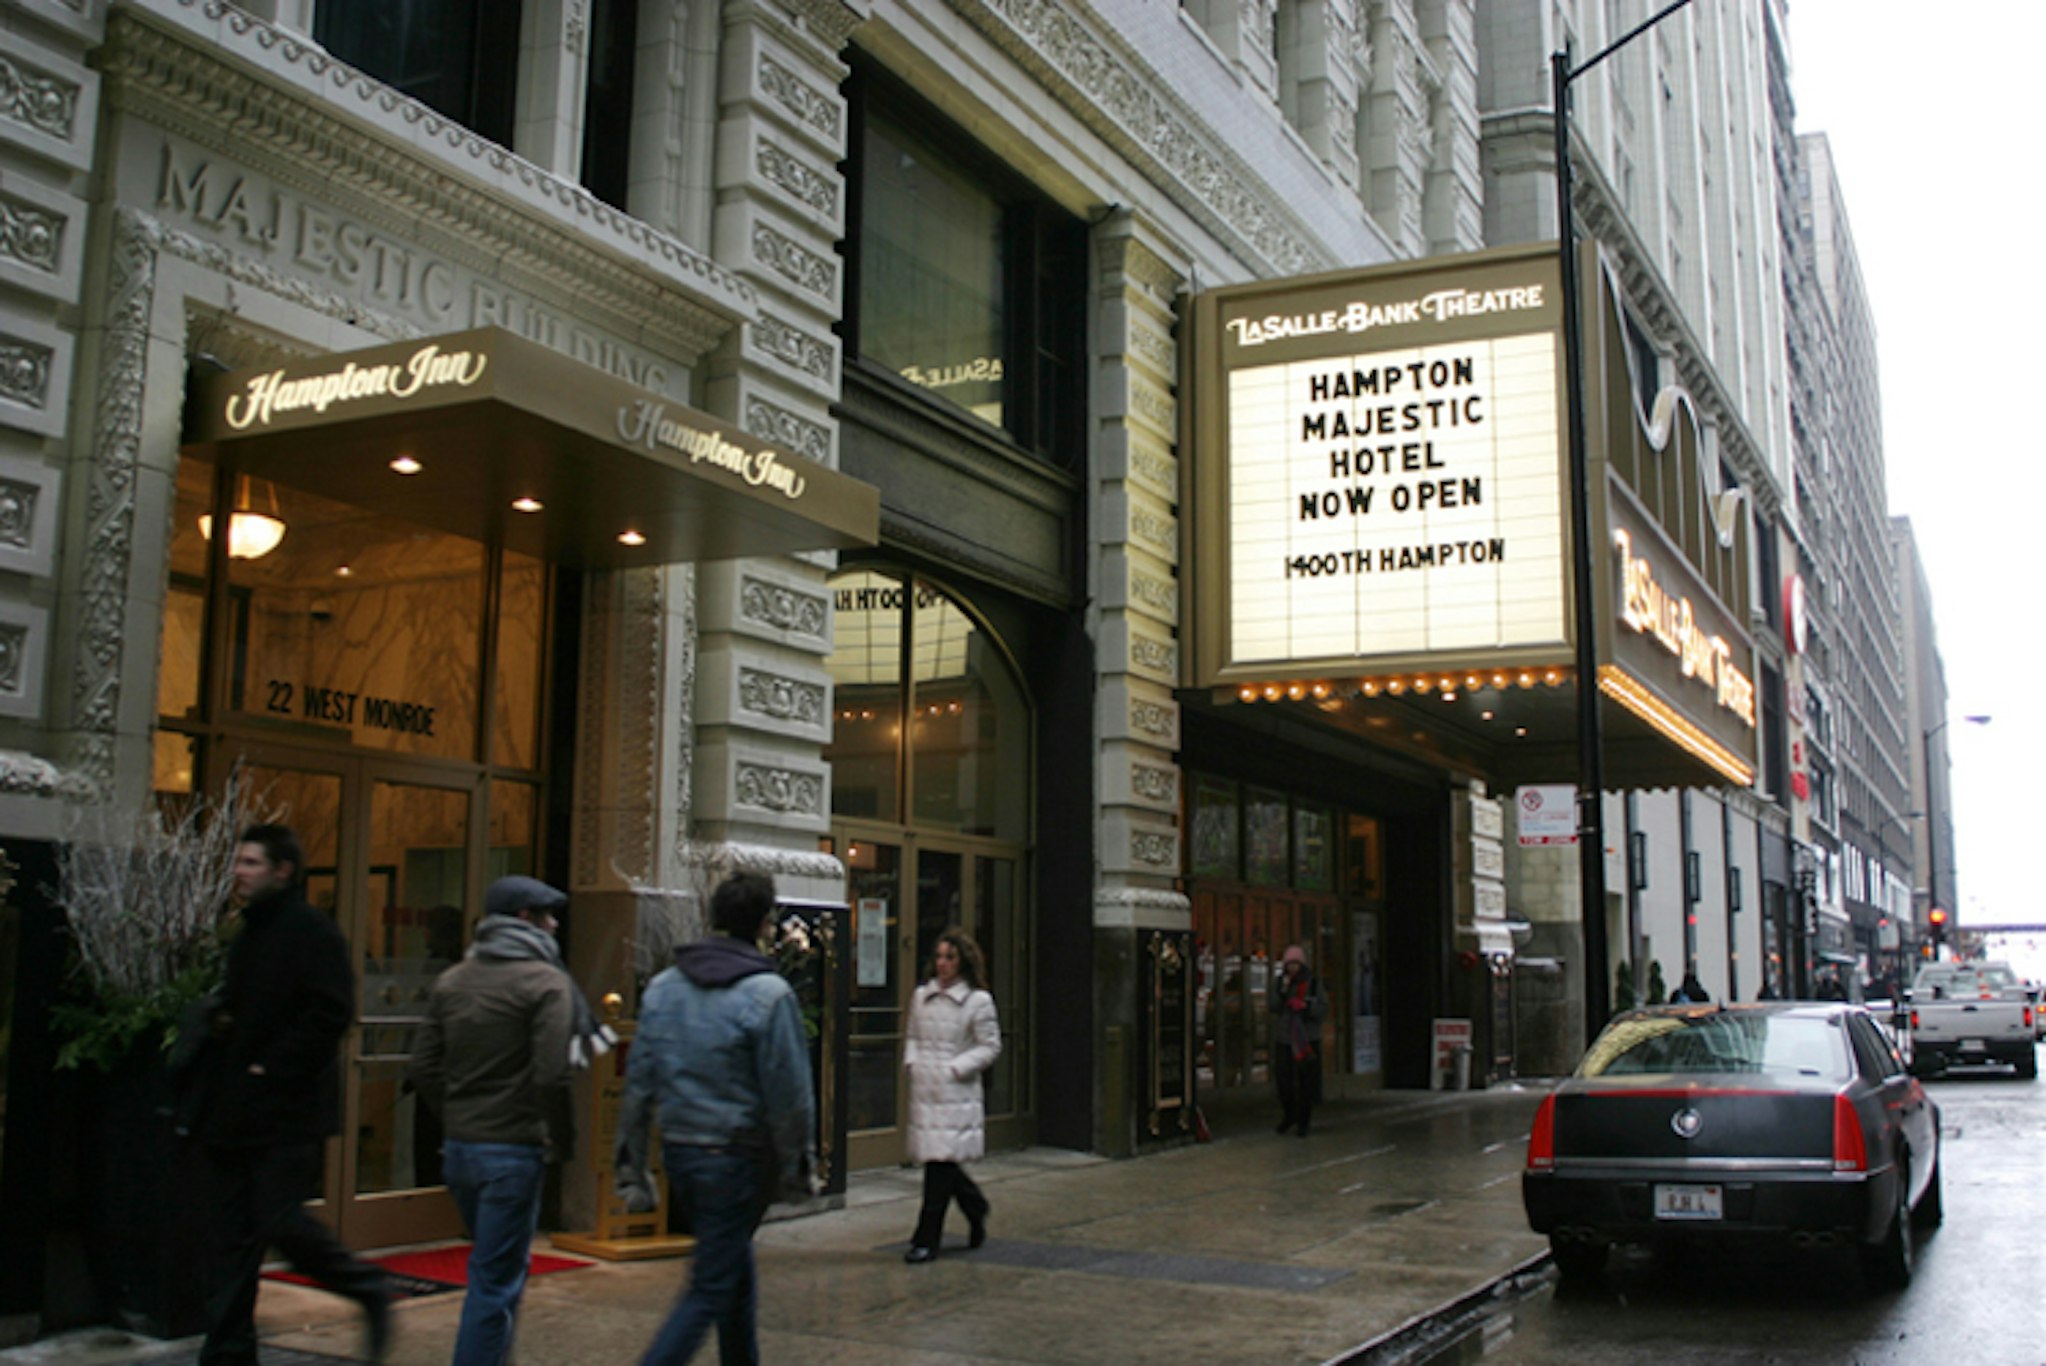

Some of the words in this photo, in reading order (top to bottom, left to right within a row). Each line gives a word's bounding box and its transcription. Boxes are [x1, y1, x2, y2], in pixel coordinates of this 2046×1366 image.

[156, 138, 455, 323] MAJESTIC
[1338, 302, 1421, 333] BANK
[1421, 285, 1544, 321] THEATRE
[225, 362, 391, 430] Hampton
[389, 344, 488, 398] Inn
[1310, 357, 1474, 402] HAMPTON
[1302, 396, 1484, 442] MAJESTIC
[617, 398, 745, 473] Hampton
[742, 450, 805, 499] Inn
[1330, 441, 1446, 478] HOTEL
[1299, 487, 1375, 521] NOW
[1391, 477, 1482, 512] OPEN
[1285, 548, 1372, 579] 1400TH
[1379, 538, 1505, 572] HAMPTON
[266, 679, 293, 713] 22
[303, 685, 358, 724] WEST
[363, 696, 436, 737] MONROE
